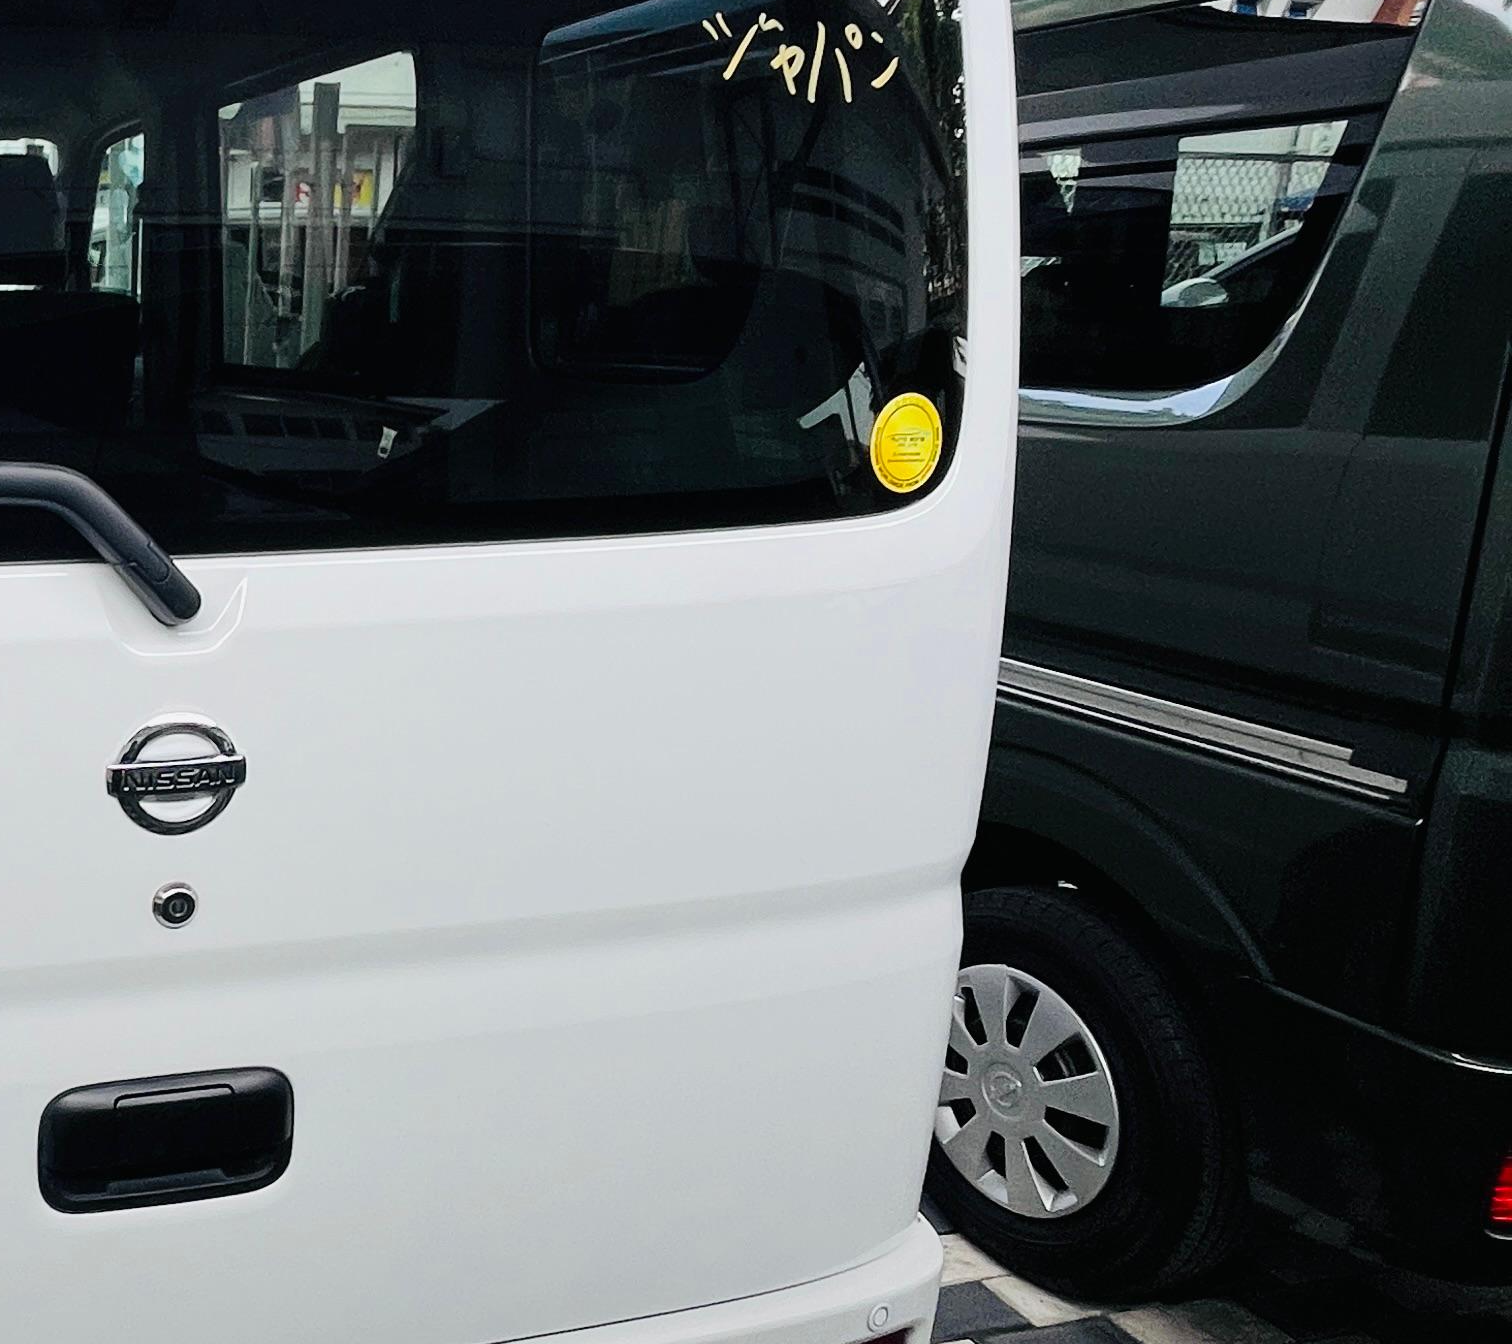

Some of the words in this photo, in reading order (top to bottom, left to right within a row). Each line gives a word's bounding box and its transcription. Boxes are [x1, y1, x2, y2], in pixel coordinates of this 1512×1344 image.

[701, 11, 900, 104] ジャパン
[121, 764, 236, 792] NISSAN
